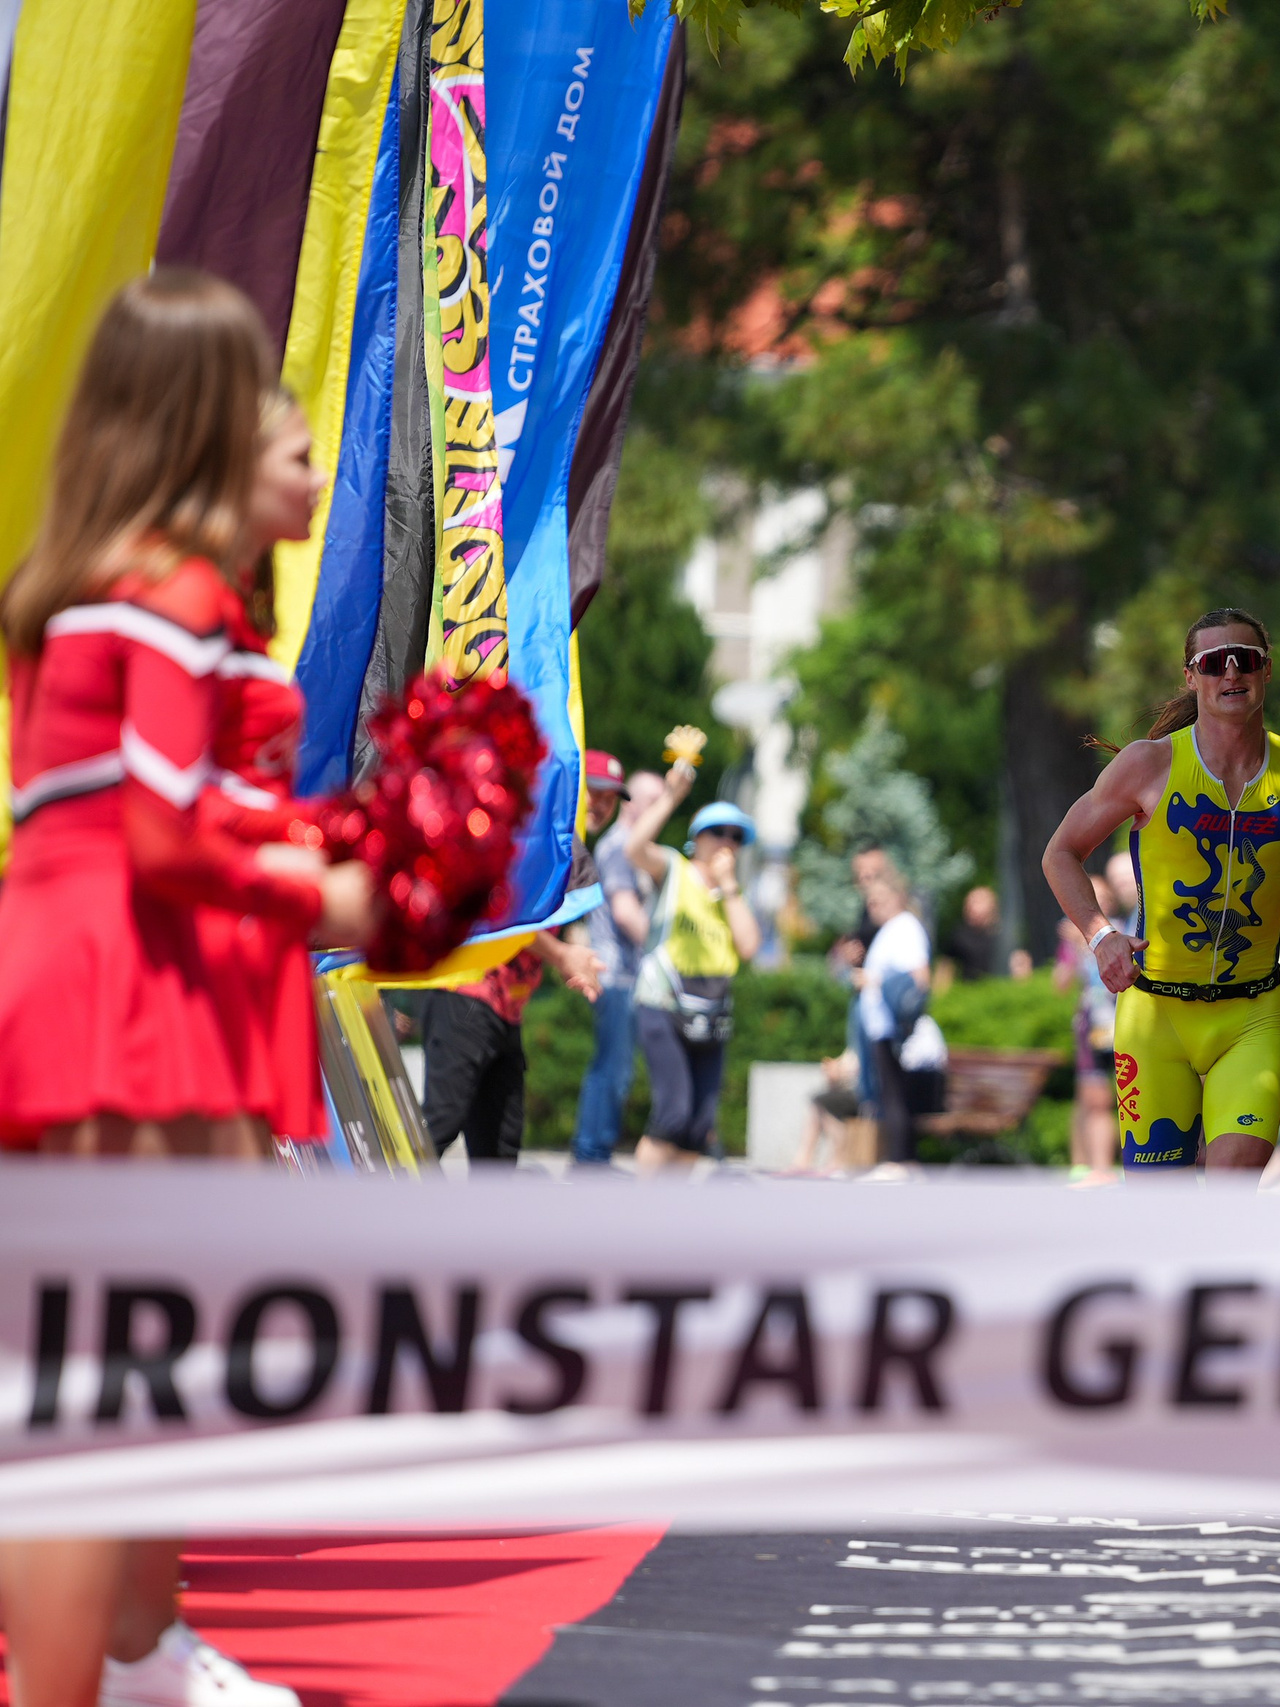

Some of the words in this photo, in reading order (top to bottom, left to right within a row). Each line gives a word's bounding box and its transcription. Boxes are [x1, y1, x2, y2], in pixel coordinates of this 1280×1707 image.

[506, 151, 568, 392] СТРАХОВОЙ
[556, 46, 596, 143] ДОМ
[28, 1276, 957, 1428] IRONSTAR
